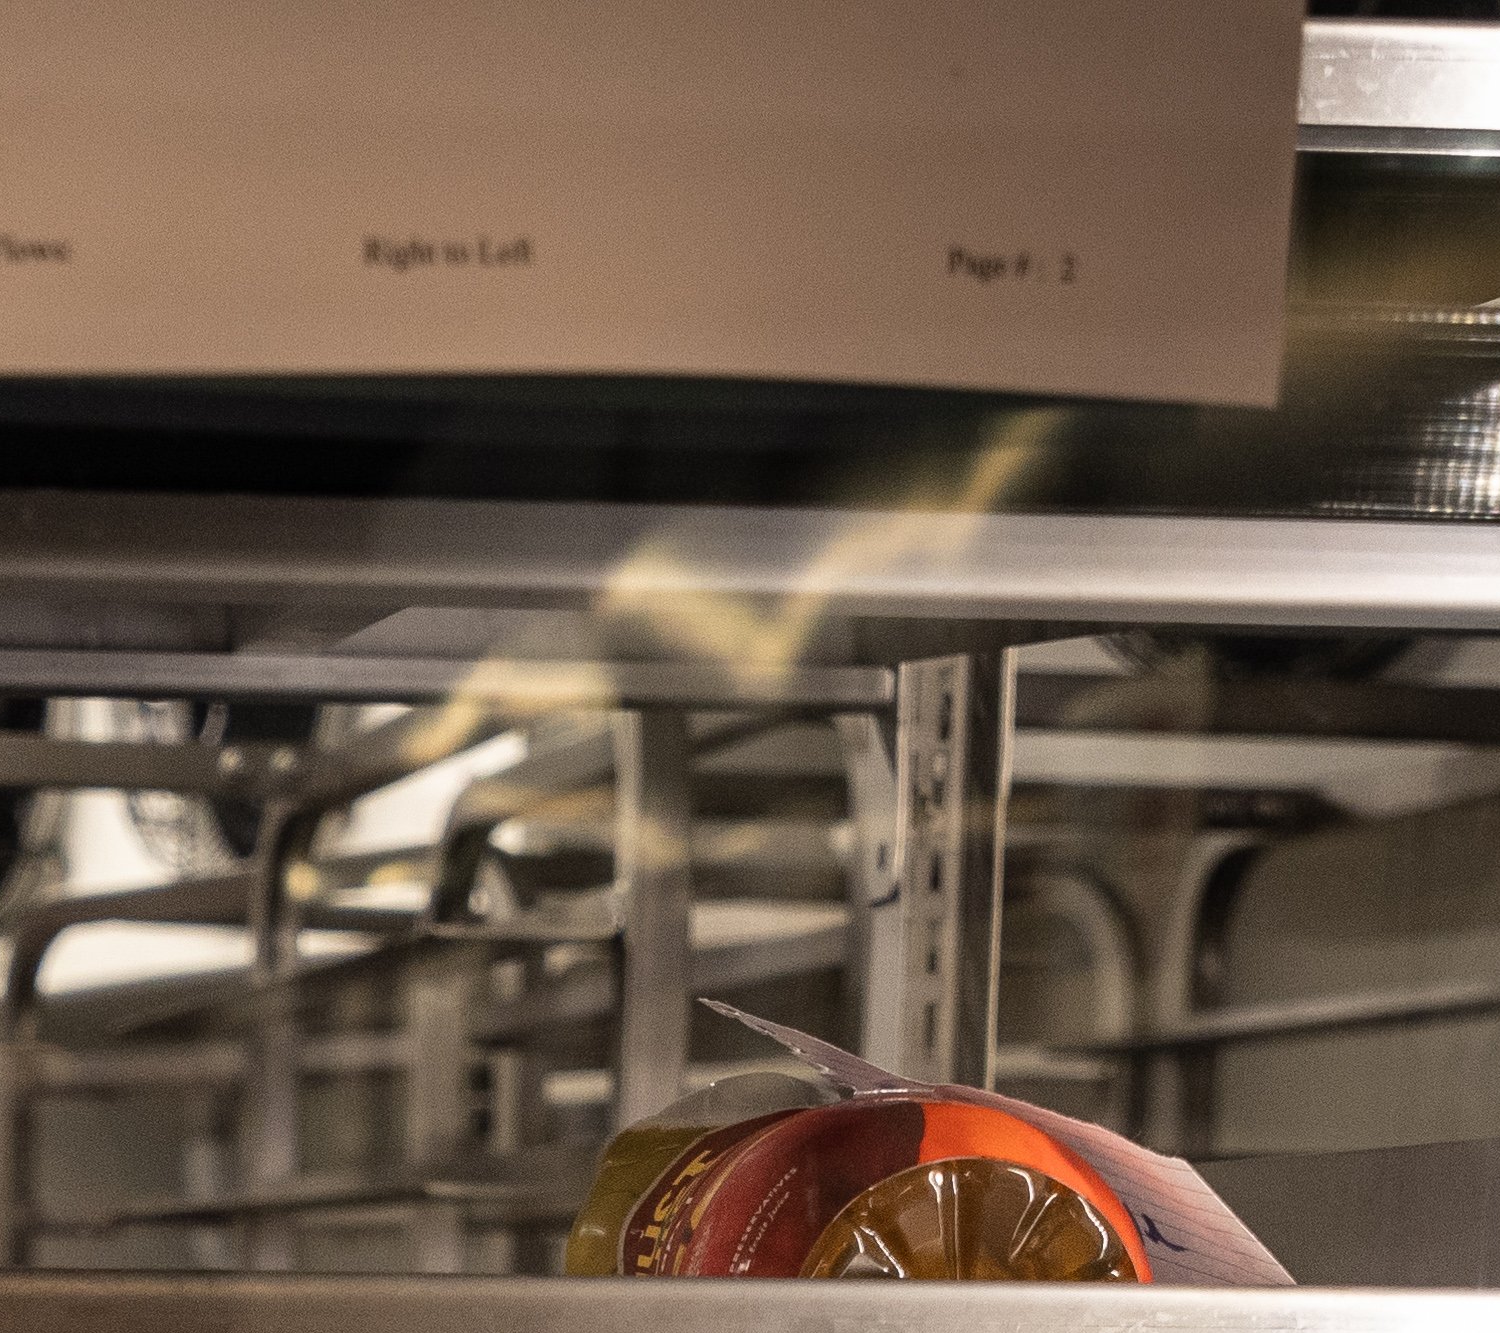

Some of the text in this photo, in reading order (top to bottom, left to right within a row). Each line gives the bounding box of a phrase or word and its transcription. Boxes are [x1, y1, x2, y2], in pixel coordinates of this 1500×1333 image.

[363, 237, 533, 272] Right to Left
[946, 246, 1006, 281] Page
